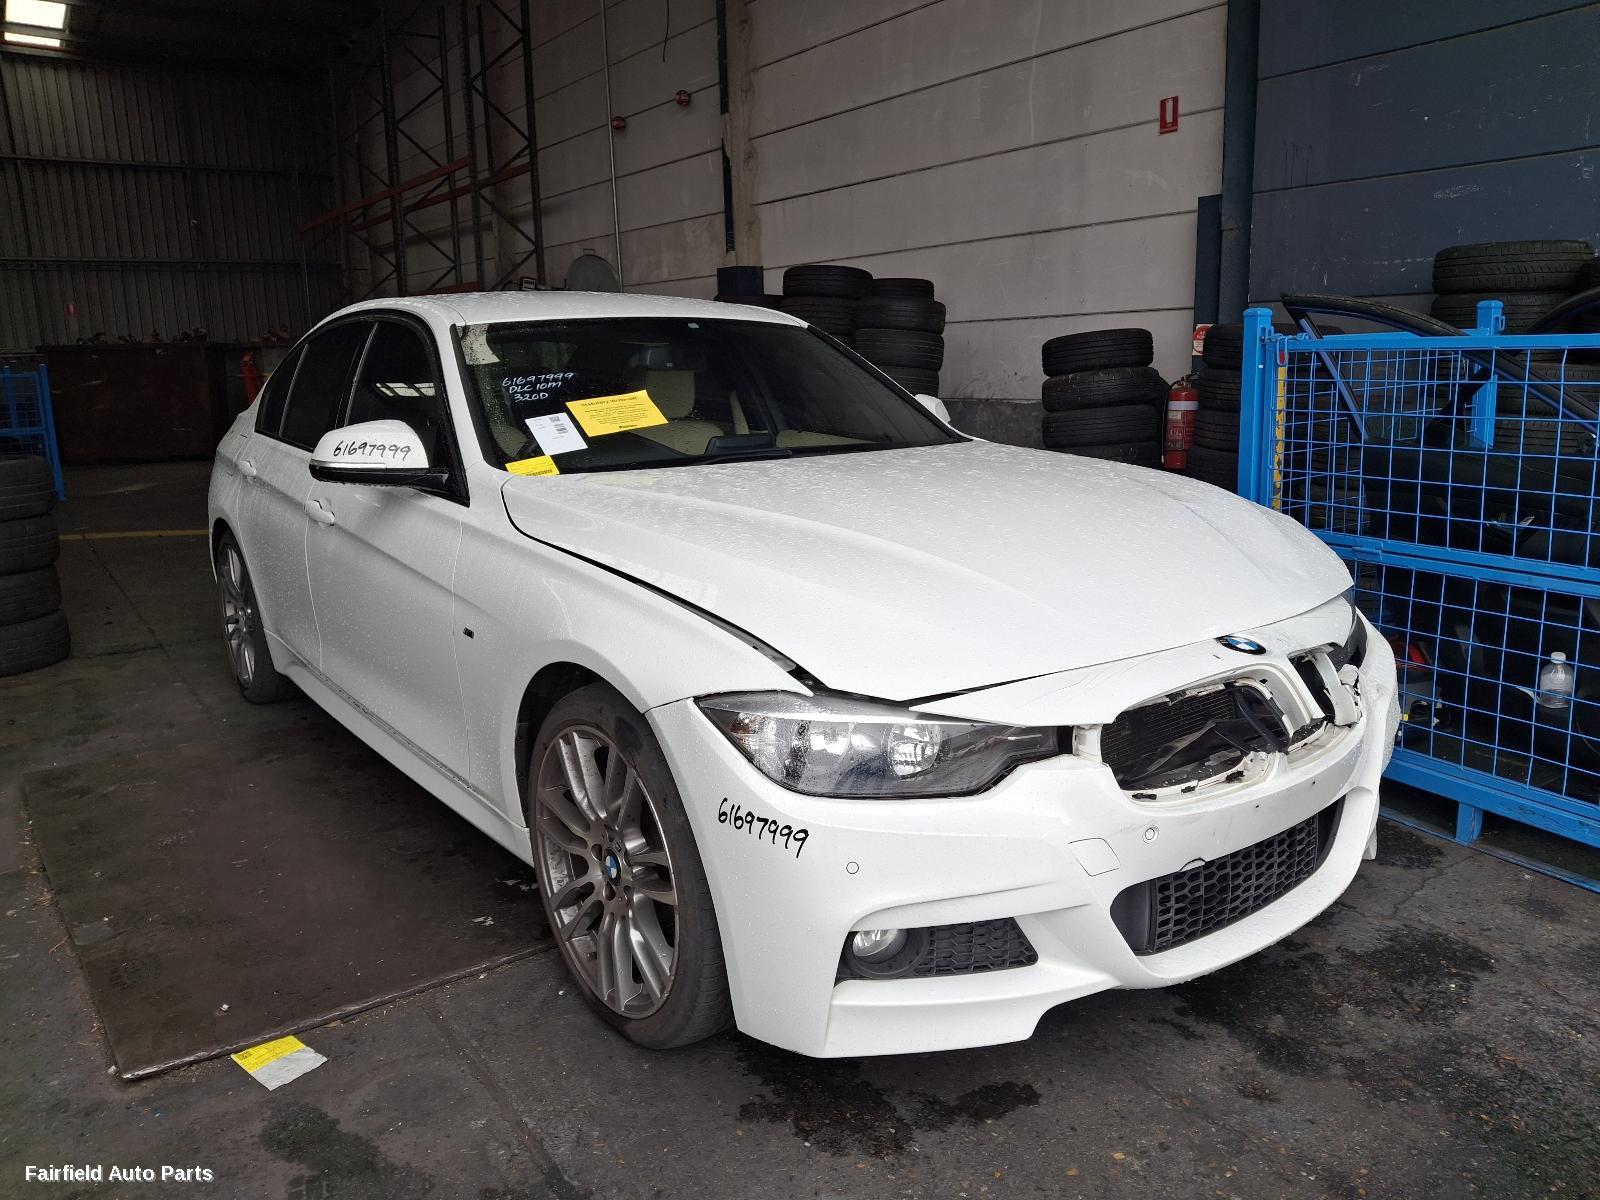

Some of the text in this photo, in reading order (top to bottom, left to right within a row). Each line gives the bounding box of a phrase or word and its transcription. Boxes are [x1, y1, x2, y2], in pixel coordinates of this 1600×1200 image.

[501, 372, 575, 387] 61697999
[509, 384, 533, 394] DLC
[514, 392, 549, 403] 320D
[333, 440, 412, 462] 61697999
[718, 797, 810, 859] 61697999
